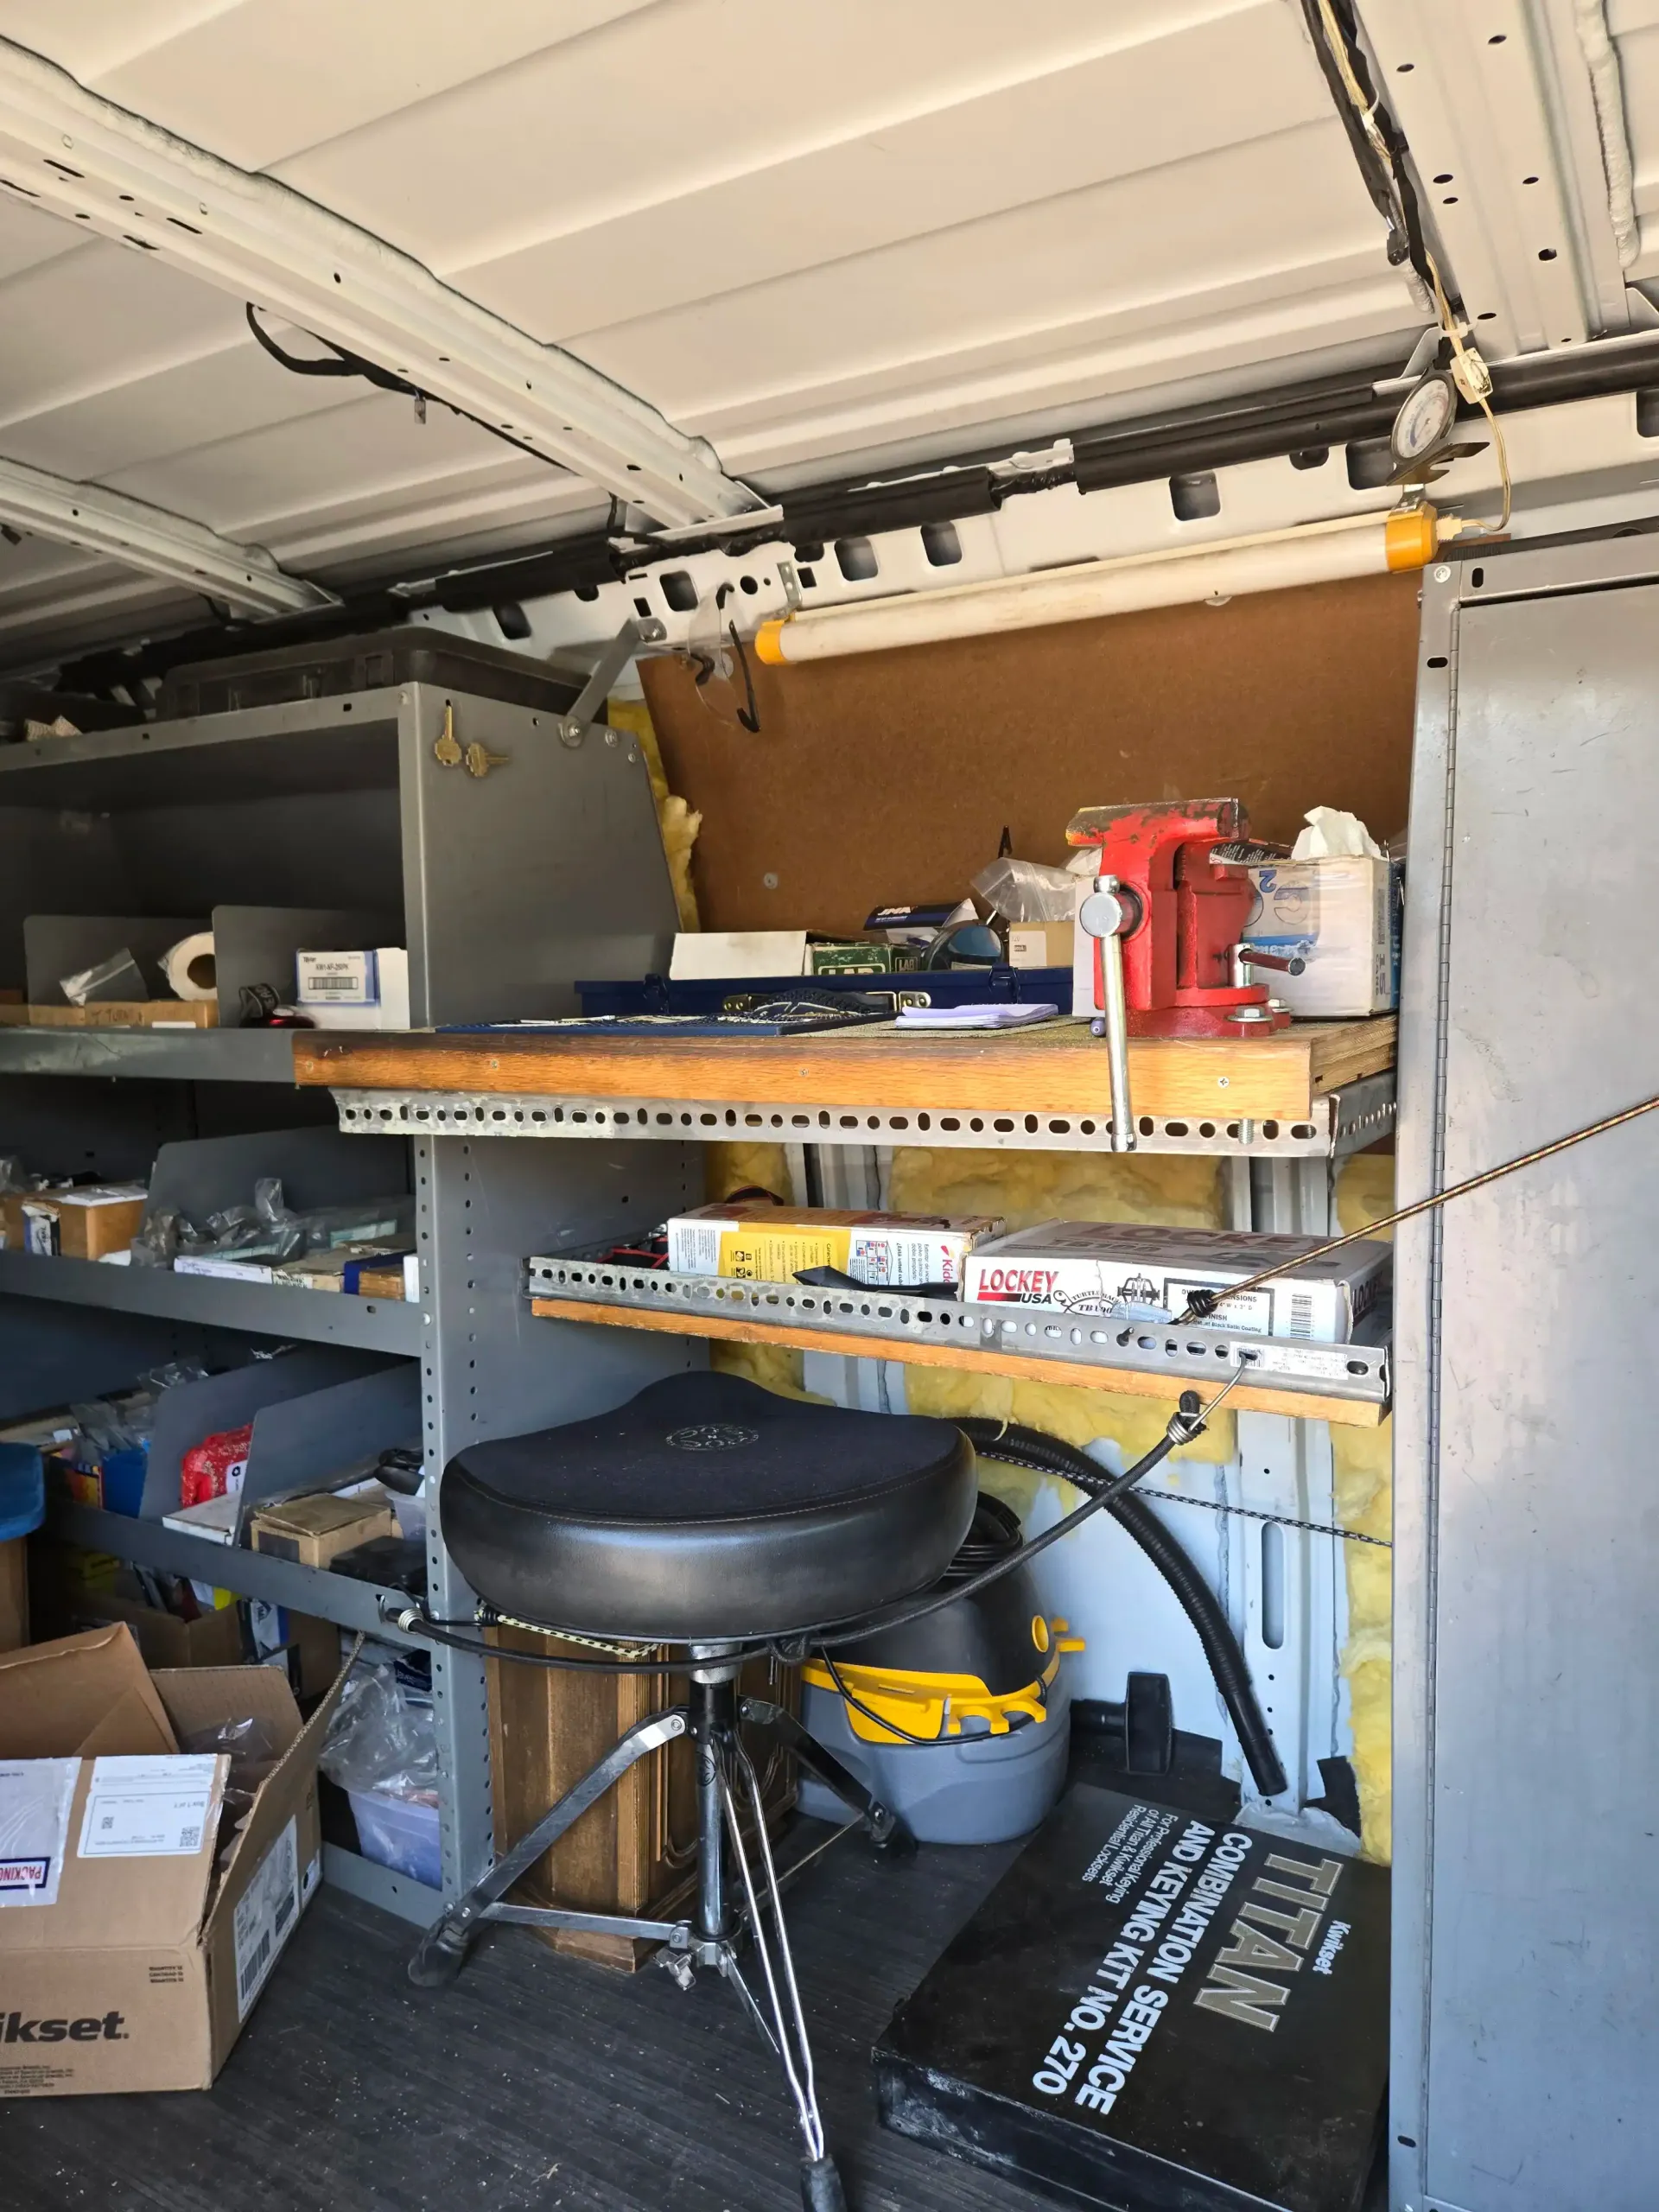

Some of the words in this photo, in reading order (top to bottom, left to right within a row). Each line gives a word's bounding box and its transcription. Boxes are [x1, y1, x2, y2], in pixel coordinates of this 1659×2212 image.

[877, 906, 911, 916] JMA
[899, 958, 914, 971] LAB
[978, 1268, 1059, 1293] LOCKEY
[1020, 1293, 1052, 1305] USA
[1107, 1803, 1147, 1851] Residential
[1141, 1817, 1155, 1829] All
[1147, 1808, 1160, 1820] of
[1160, 1813, 1179, 1828] For
[1126, 1845, 1138, 1857] &
[1127, 1826, 1170, 1877] Professional
[1128, 1825, 1149, 1848] Titan
[1172, 1820, 1216, 1862] AND
[1082, 1846, 1112, 1884] Locksets
[1099, 1849, 1133, 1886] Kwikset
[1105, 1873, 1140, 1904] Keying
[1120, 1861, 1193, 1942] KEYING
[1146, 1832, 1253, 1984] COMBINATION
[1193, 1853, 1344, 2032] TITAN
[1313, 1919, 1352, 1975] Kwikset
[1096, 1942, 1146, 1990] KIT
[1064, 1985, 1120, 2031] NO.
[1033, 2035, 1087, 2095] 270
[1074, 1985, 1169, 2115] SERVICE
